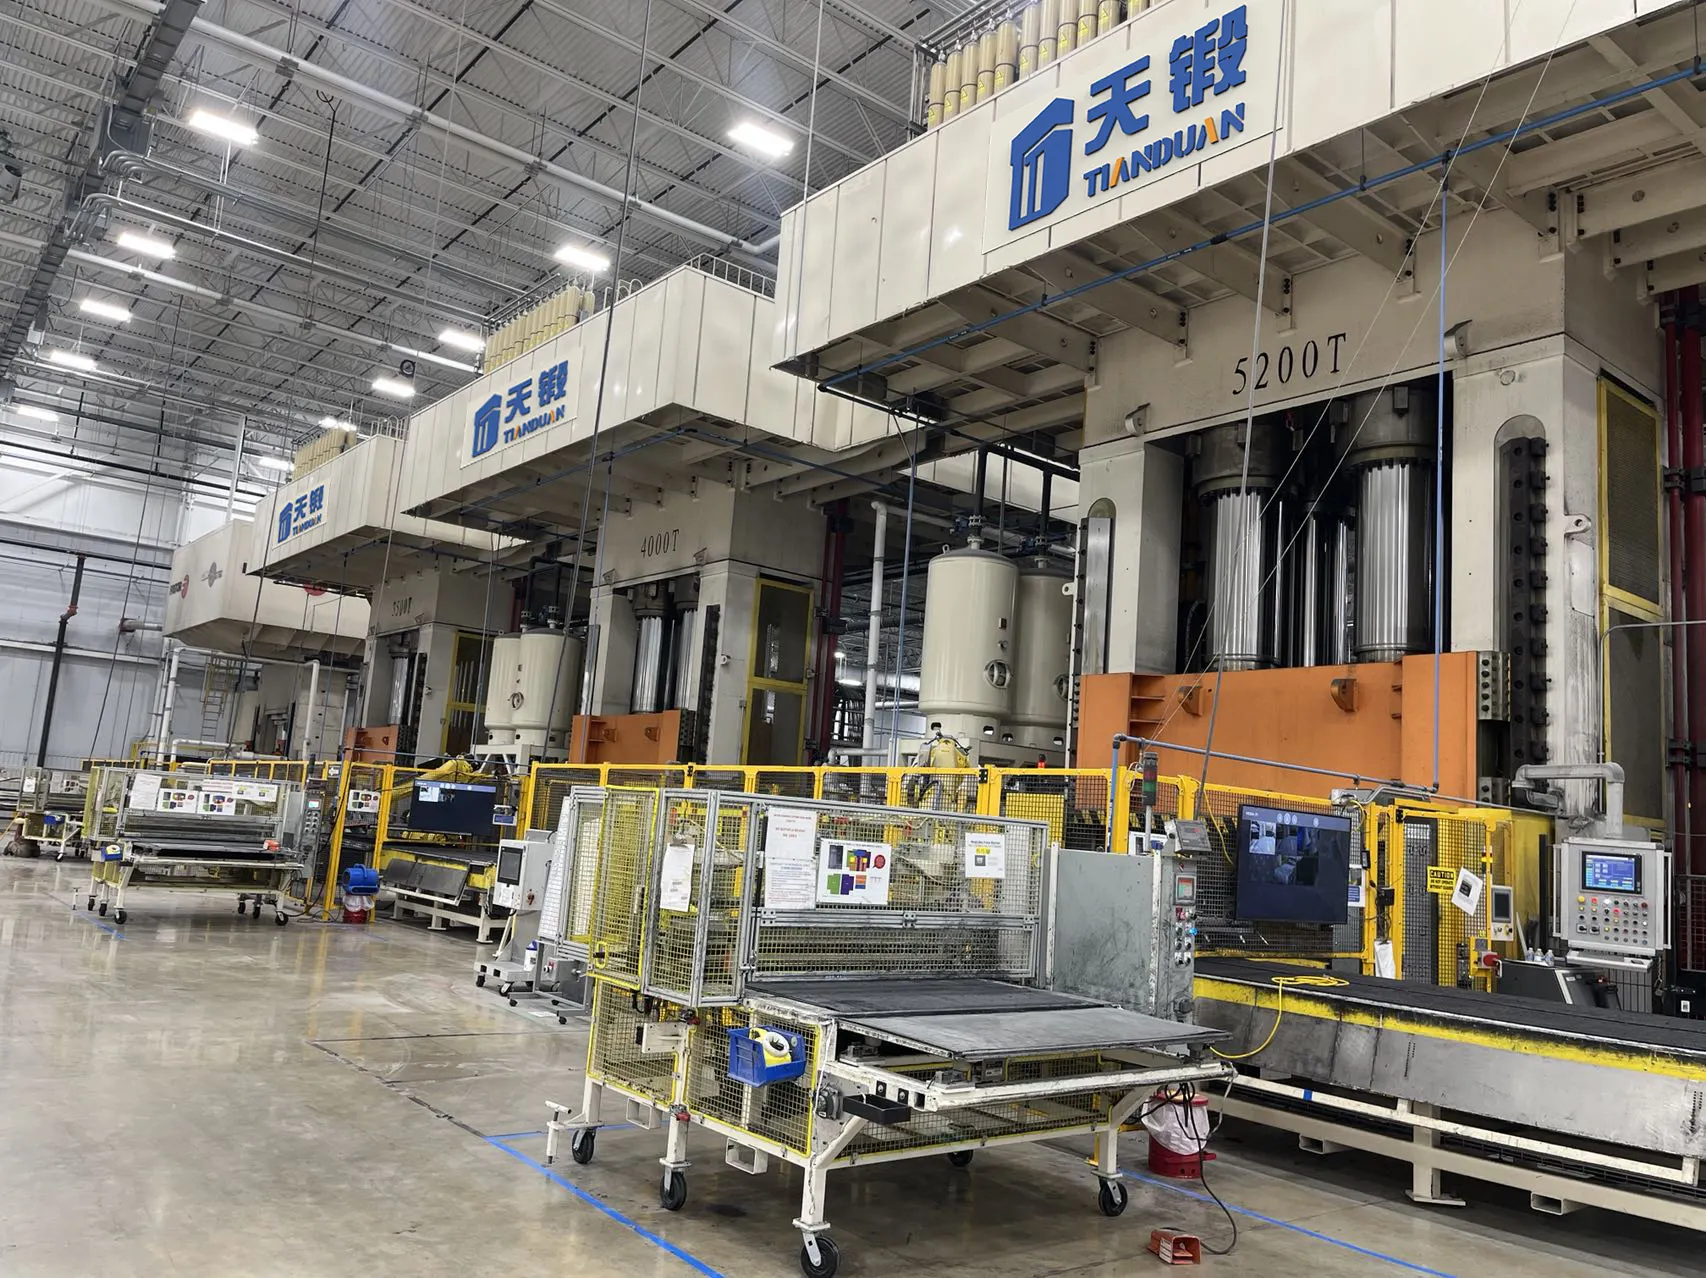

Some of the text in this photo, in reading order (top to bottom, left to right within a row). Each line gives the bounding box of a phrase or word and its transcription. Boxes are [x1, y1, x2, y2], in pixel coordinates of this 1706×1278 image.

[1085, 5, 1247, 156] 天锻
[1083, 102, 1245, 197] TIANDUAN
[504, 360, 568, 424] 天锻
[1232, 332, 1346, 395] 5200T
[503, 404, 565, 444] TIANDUAN
[640, 528, 679, 559] 4000T
[1430, 870, 1453, 878] CAUTION
